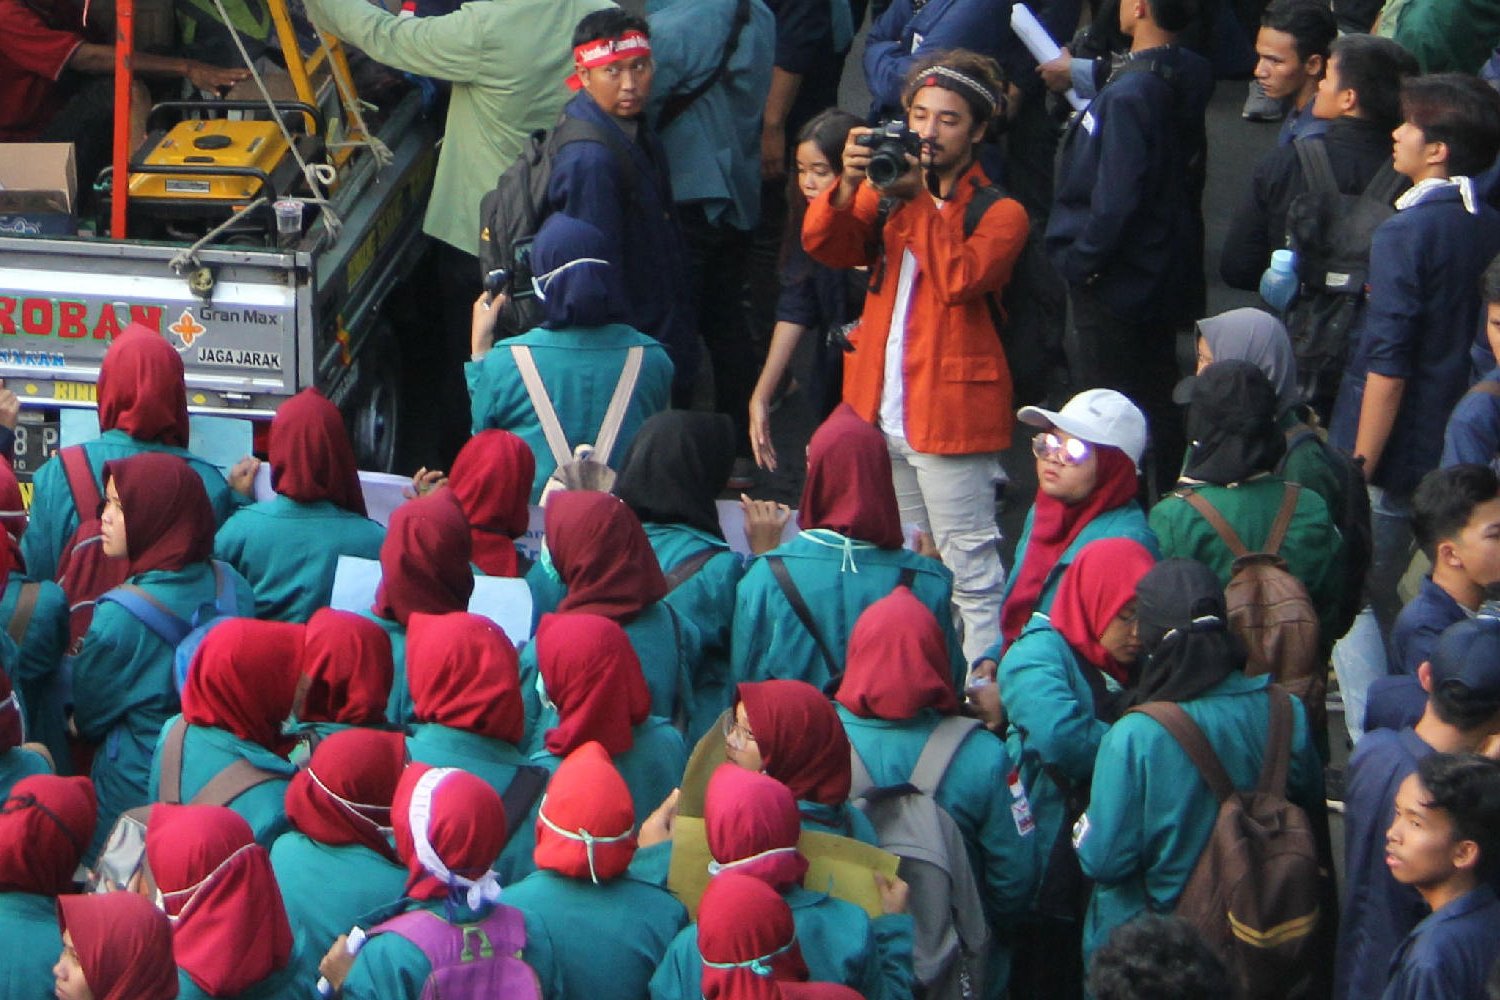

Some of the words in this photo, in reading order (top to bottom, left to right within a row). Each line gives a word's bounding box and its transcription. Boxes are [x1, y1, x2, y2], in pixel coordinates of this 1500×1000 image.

[200, 306, 230, 322] Gran
[243, 309, 278, 325] Max
[198, 348, 234, 364] JAGA
[236, 351, 280, 368] JARAK
